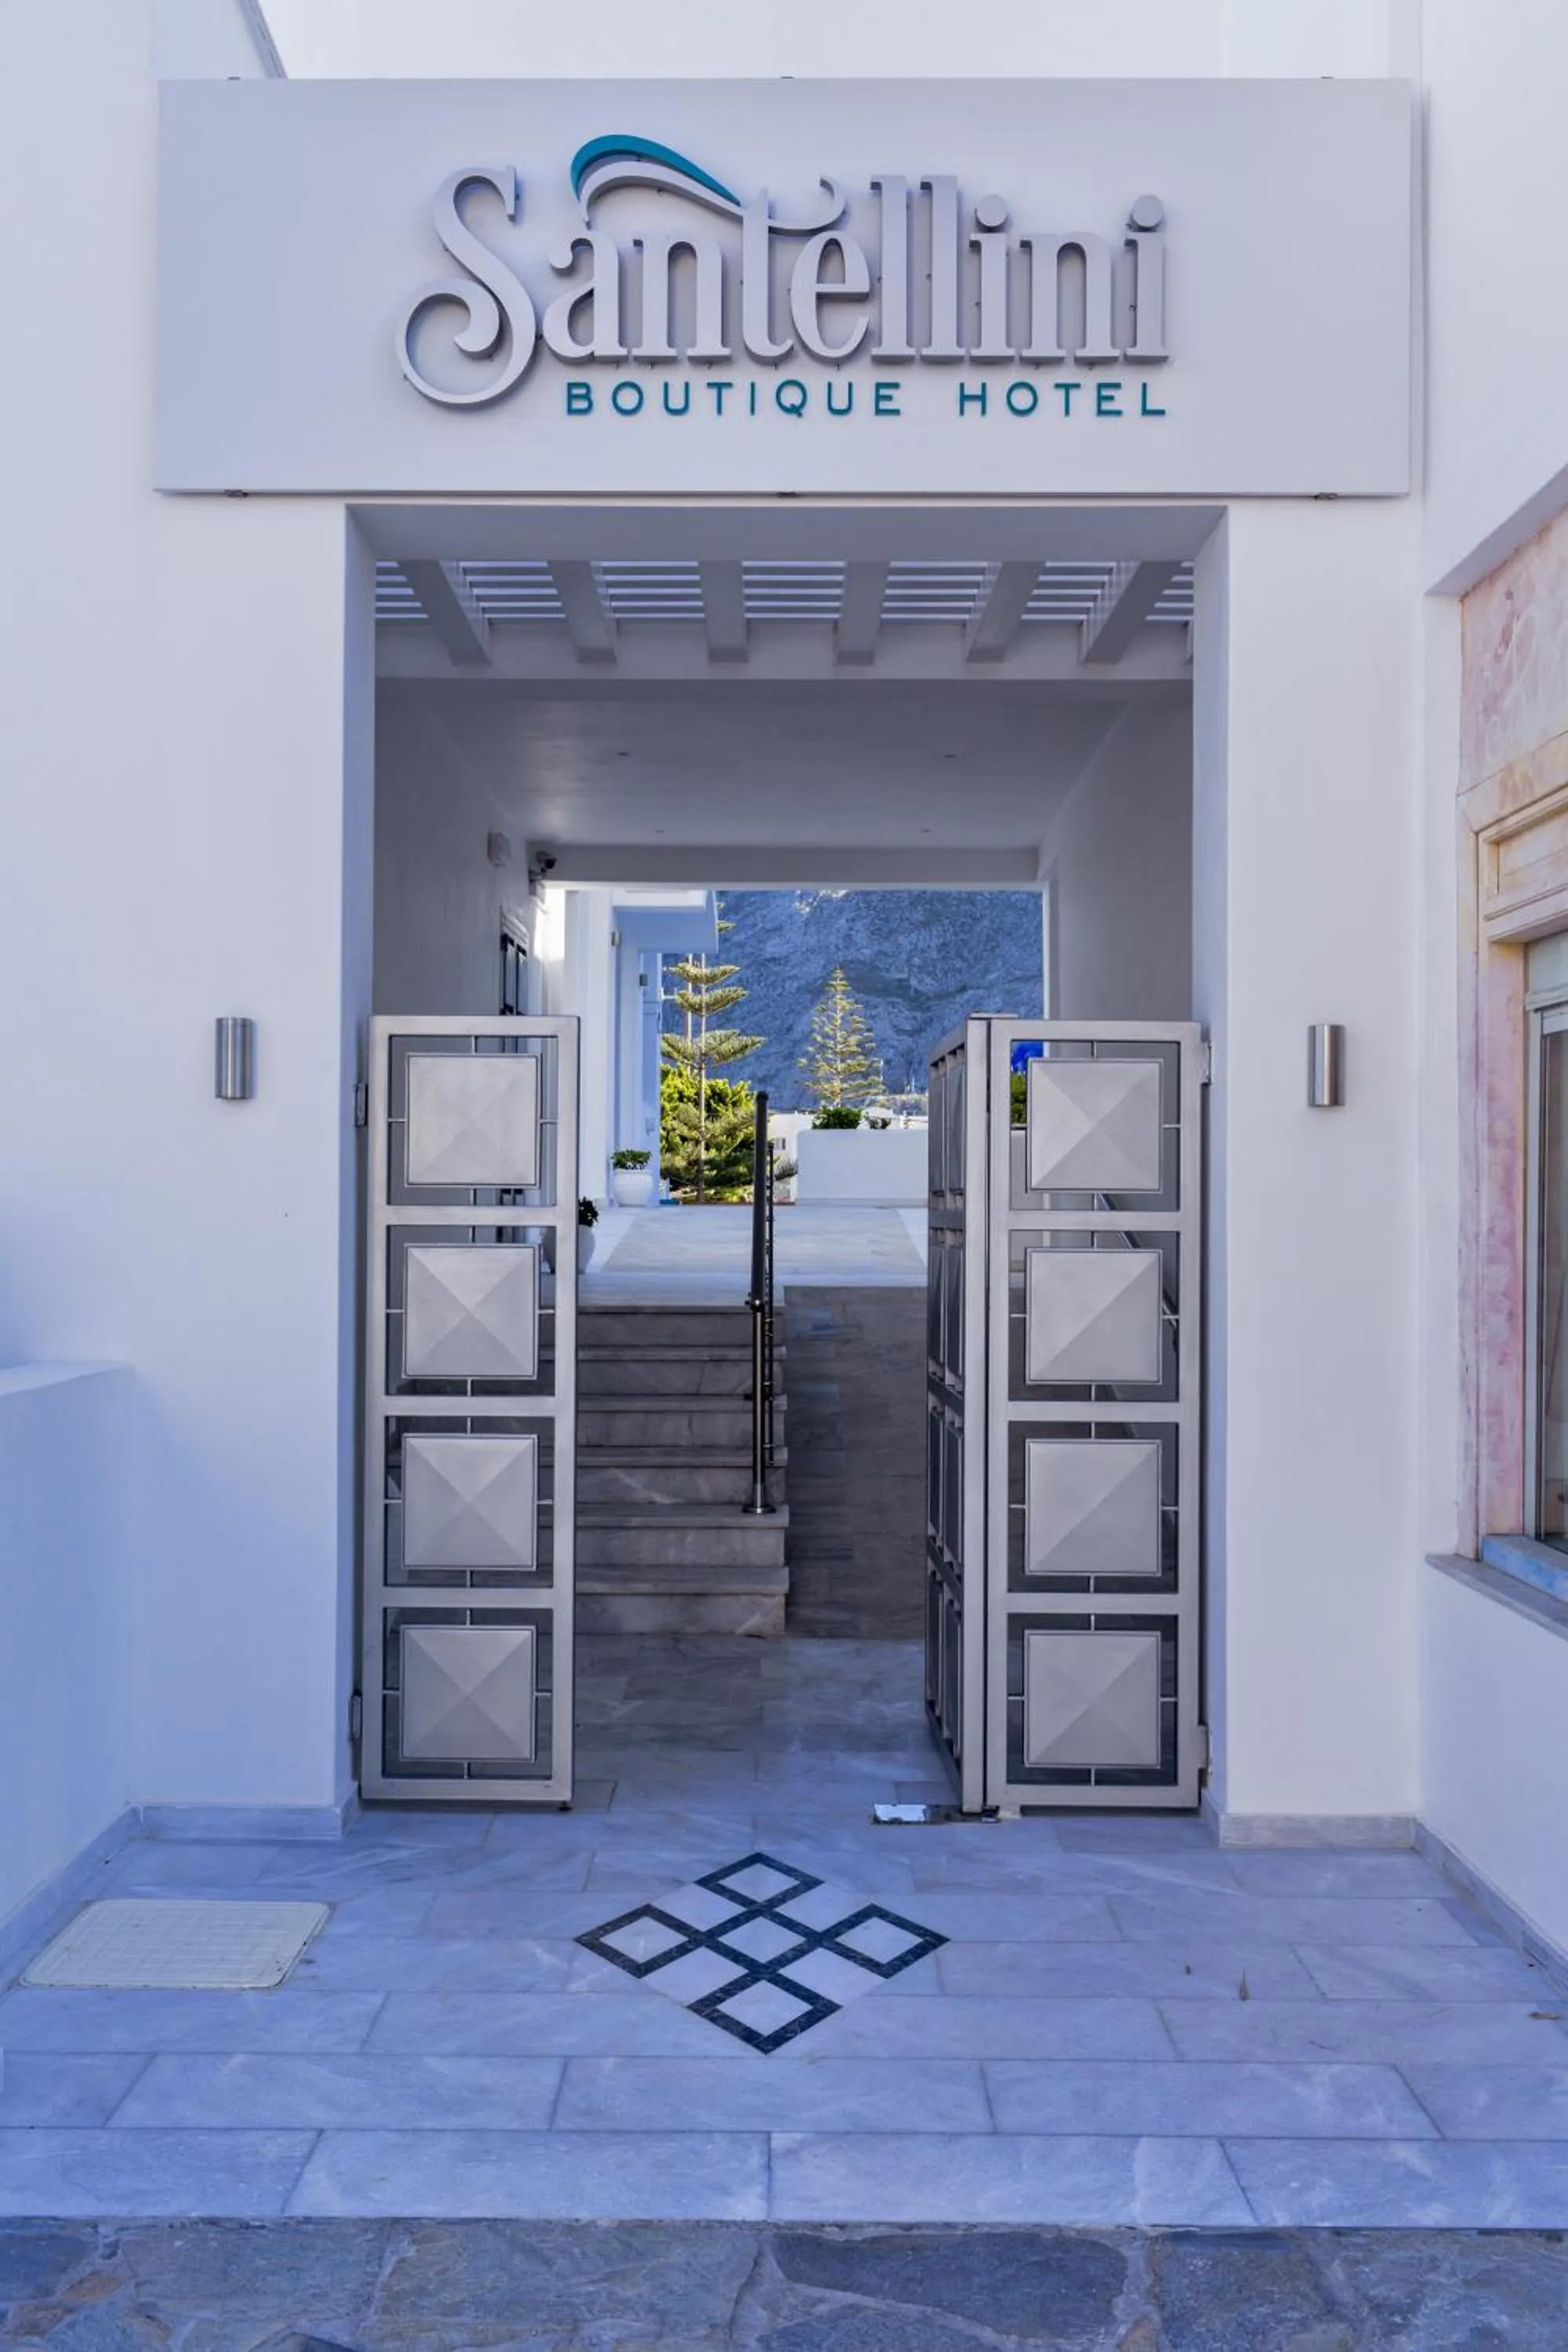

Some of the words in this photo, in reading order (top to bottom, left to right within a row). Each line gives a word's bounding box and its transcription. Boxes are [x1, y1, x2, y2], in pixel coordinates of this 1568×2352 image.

[395, 154, 1169, 406] Santellini
[565, 379, 901, 418] BOUTIQUE
[959, 381, 1166, 417] HOTEL
